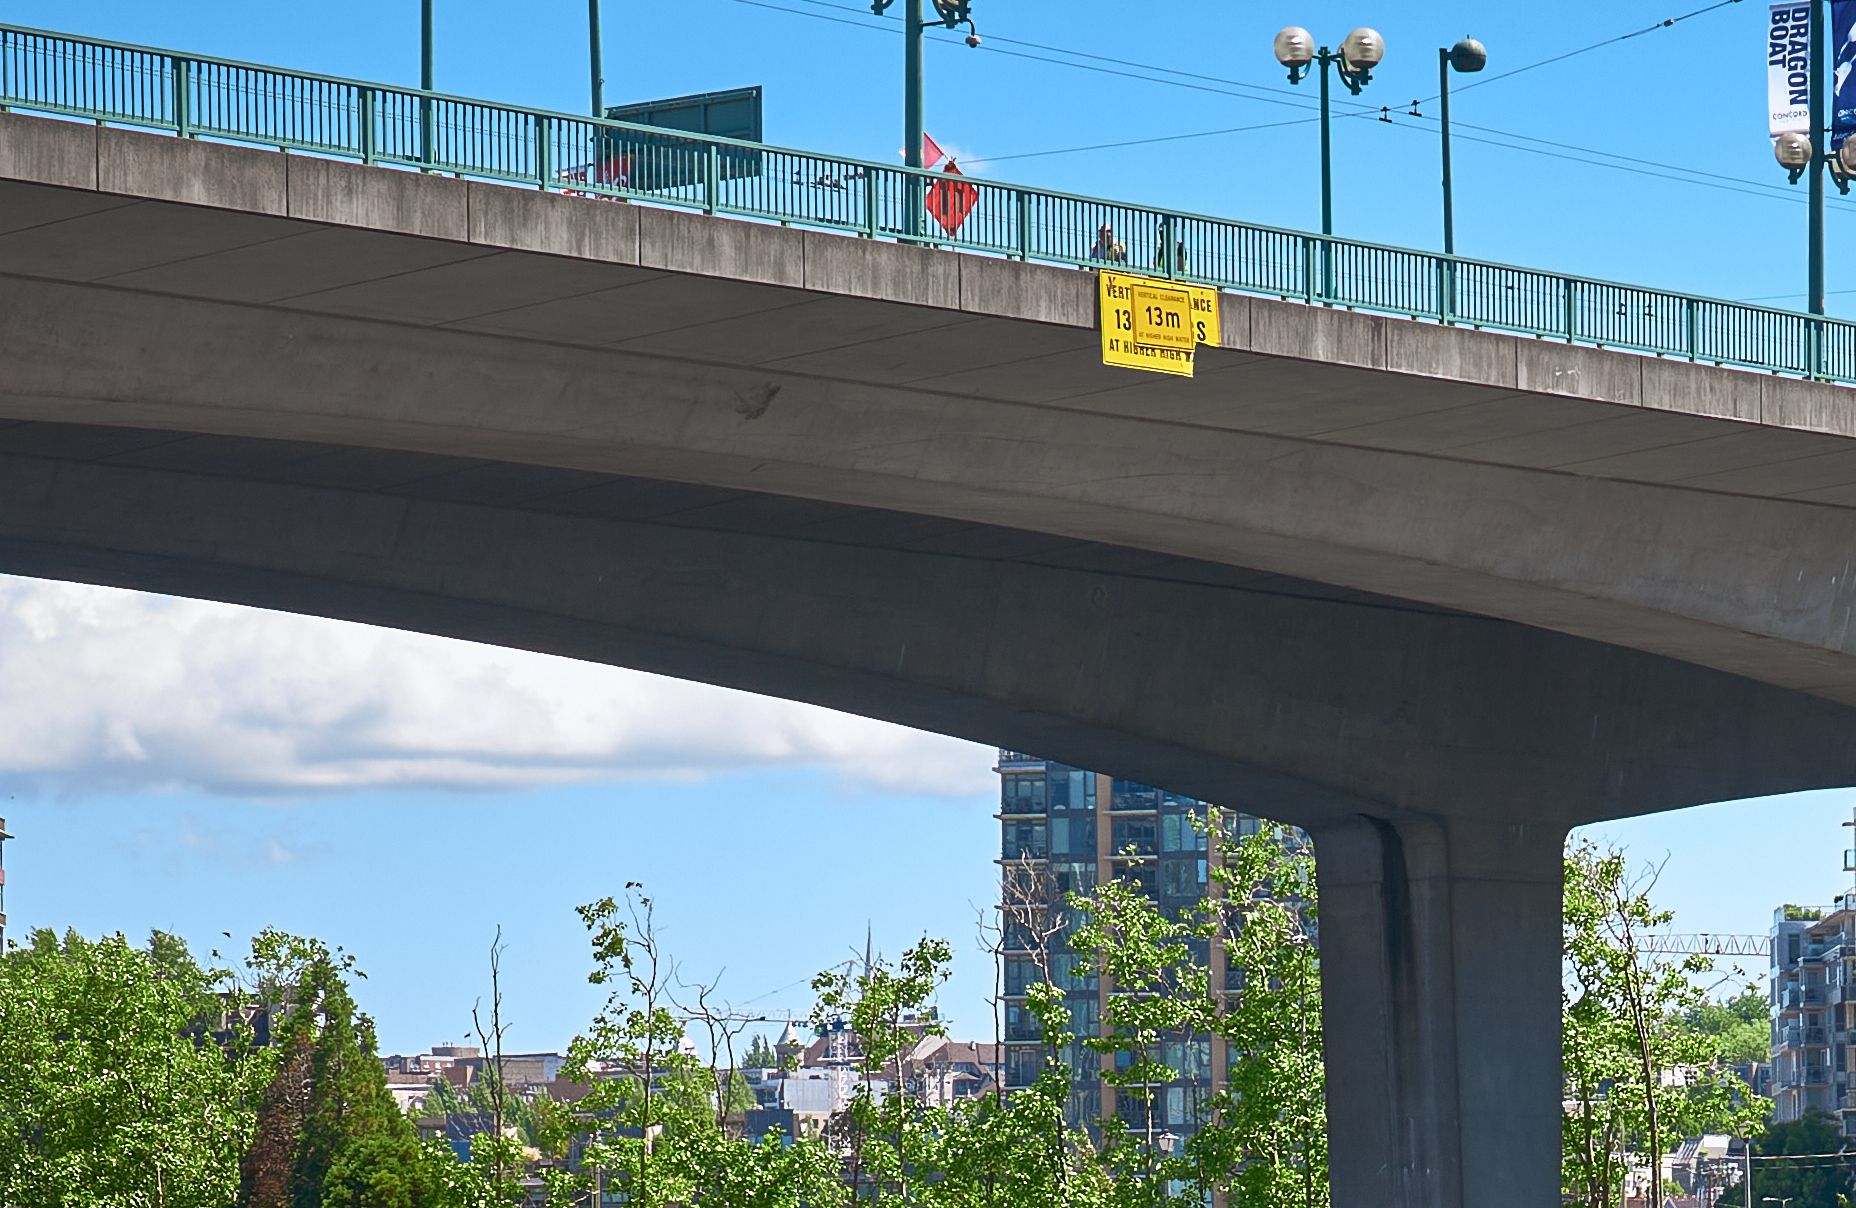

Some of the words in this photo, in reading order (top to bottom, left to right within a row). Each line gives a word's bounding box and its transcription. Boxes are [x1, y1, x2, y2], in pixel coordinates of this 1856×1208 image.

[1769, 10, 1790, 68] BOAT
[1788, 8, 1808, 105] DRAGON
[1772, 110, 1808, 120] CONCORD
[1106, 281, 1131, 300] VERT
[1146, 305, 1180, 329] 13m
[1109, 338, 1120, 351] AT
